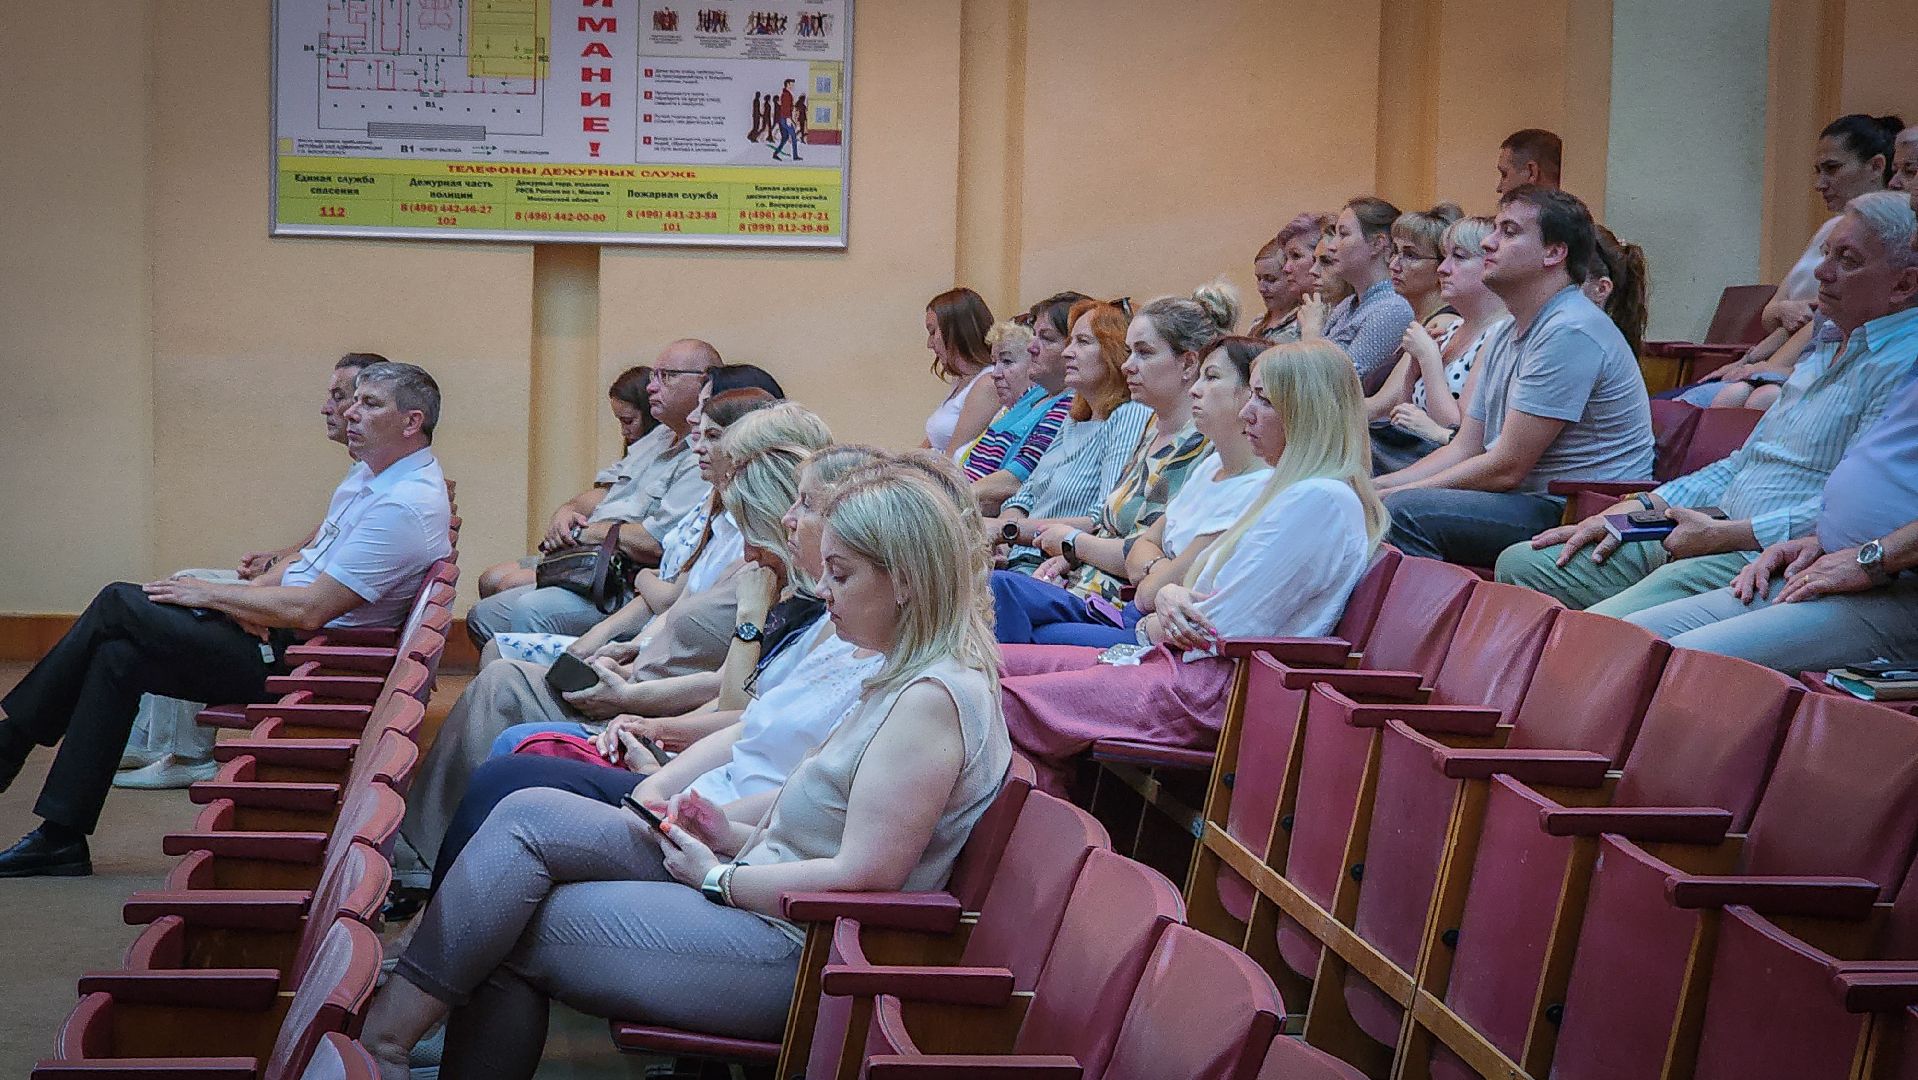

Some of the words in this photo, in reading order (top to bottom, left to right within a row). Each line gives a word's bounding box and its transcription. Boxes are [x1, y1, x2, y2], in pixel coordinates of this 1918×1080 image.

[400, 145, 414, 153] В1
[448, 165, 536, 174] ТЕЛЕФОНЫ
[541, 168, 635, 177] ДЕЖУРНЫХ
[640, 170, 696, 178] СЛУЖБ
[295, 174, 332, 183] Единая
[337, 176, 376, 184] служба
[409, 178, 462, 188] Дежурная
[310, 187, 360, 195] спасения
[430, 191, 474, 200] полиции
[627, 190, 680, 200] Пожарная
[682, 191, 719, 200] служба
[320, 207, 346, 218] 112
[515, 212, 522, 220] 8
[626, 210, 633, 218] 8
[739, 210, 746, 218] 8
[436, 216, 457, 226] 102
[663, 223, 681, 232] 101
[738, 223, 746, 232] 8
